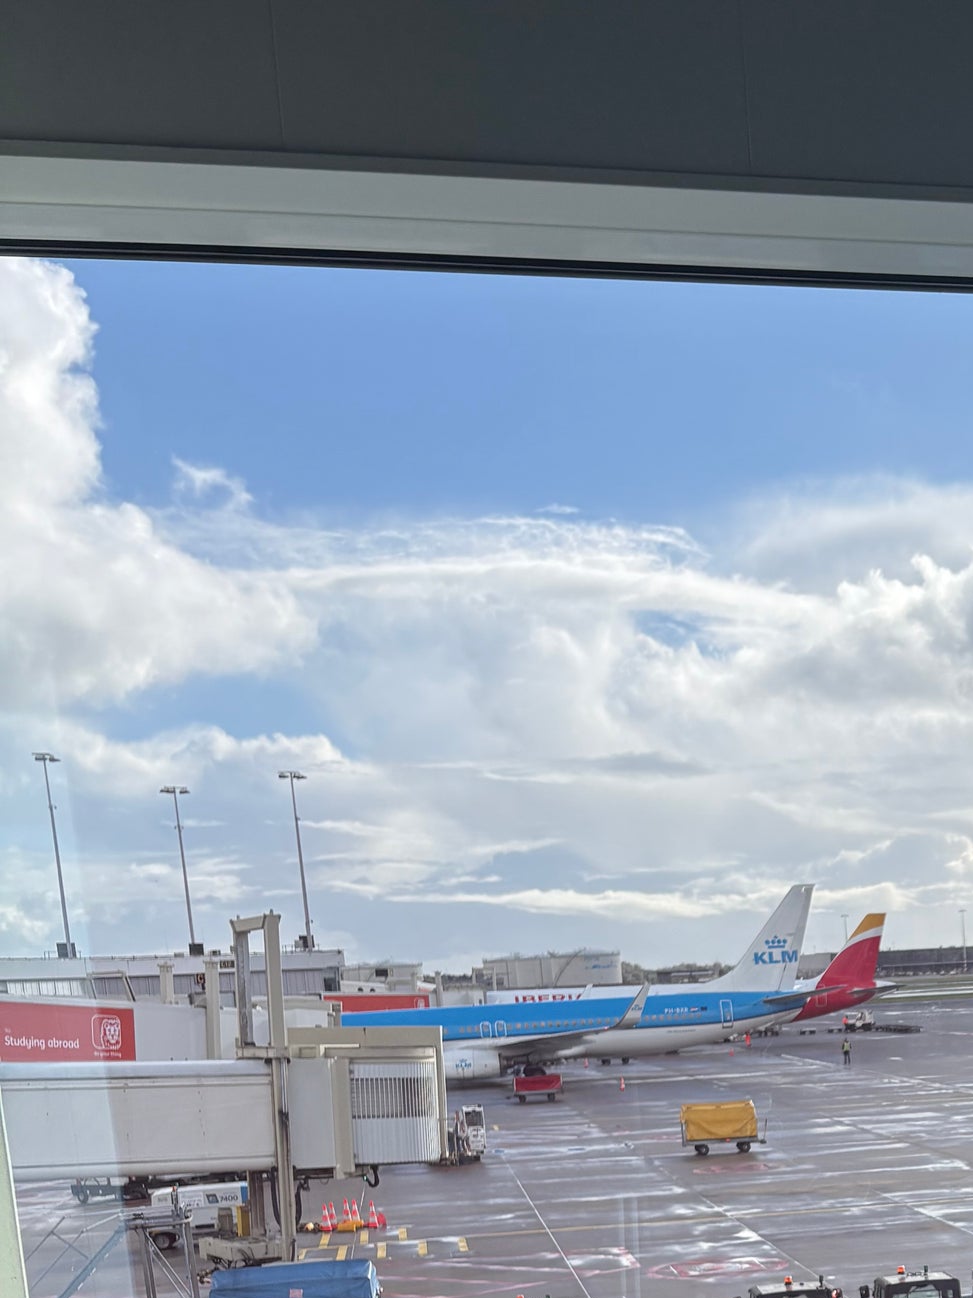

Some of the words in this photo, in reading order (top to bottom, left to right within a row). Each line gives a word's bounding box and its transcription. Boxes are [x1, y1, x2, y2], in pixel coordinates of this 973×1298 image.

[753, 950, 798, 965] KLM
[4, 1035, 46, 1050] Studying
[47, 1037, 80, 1049] abroad
